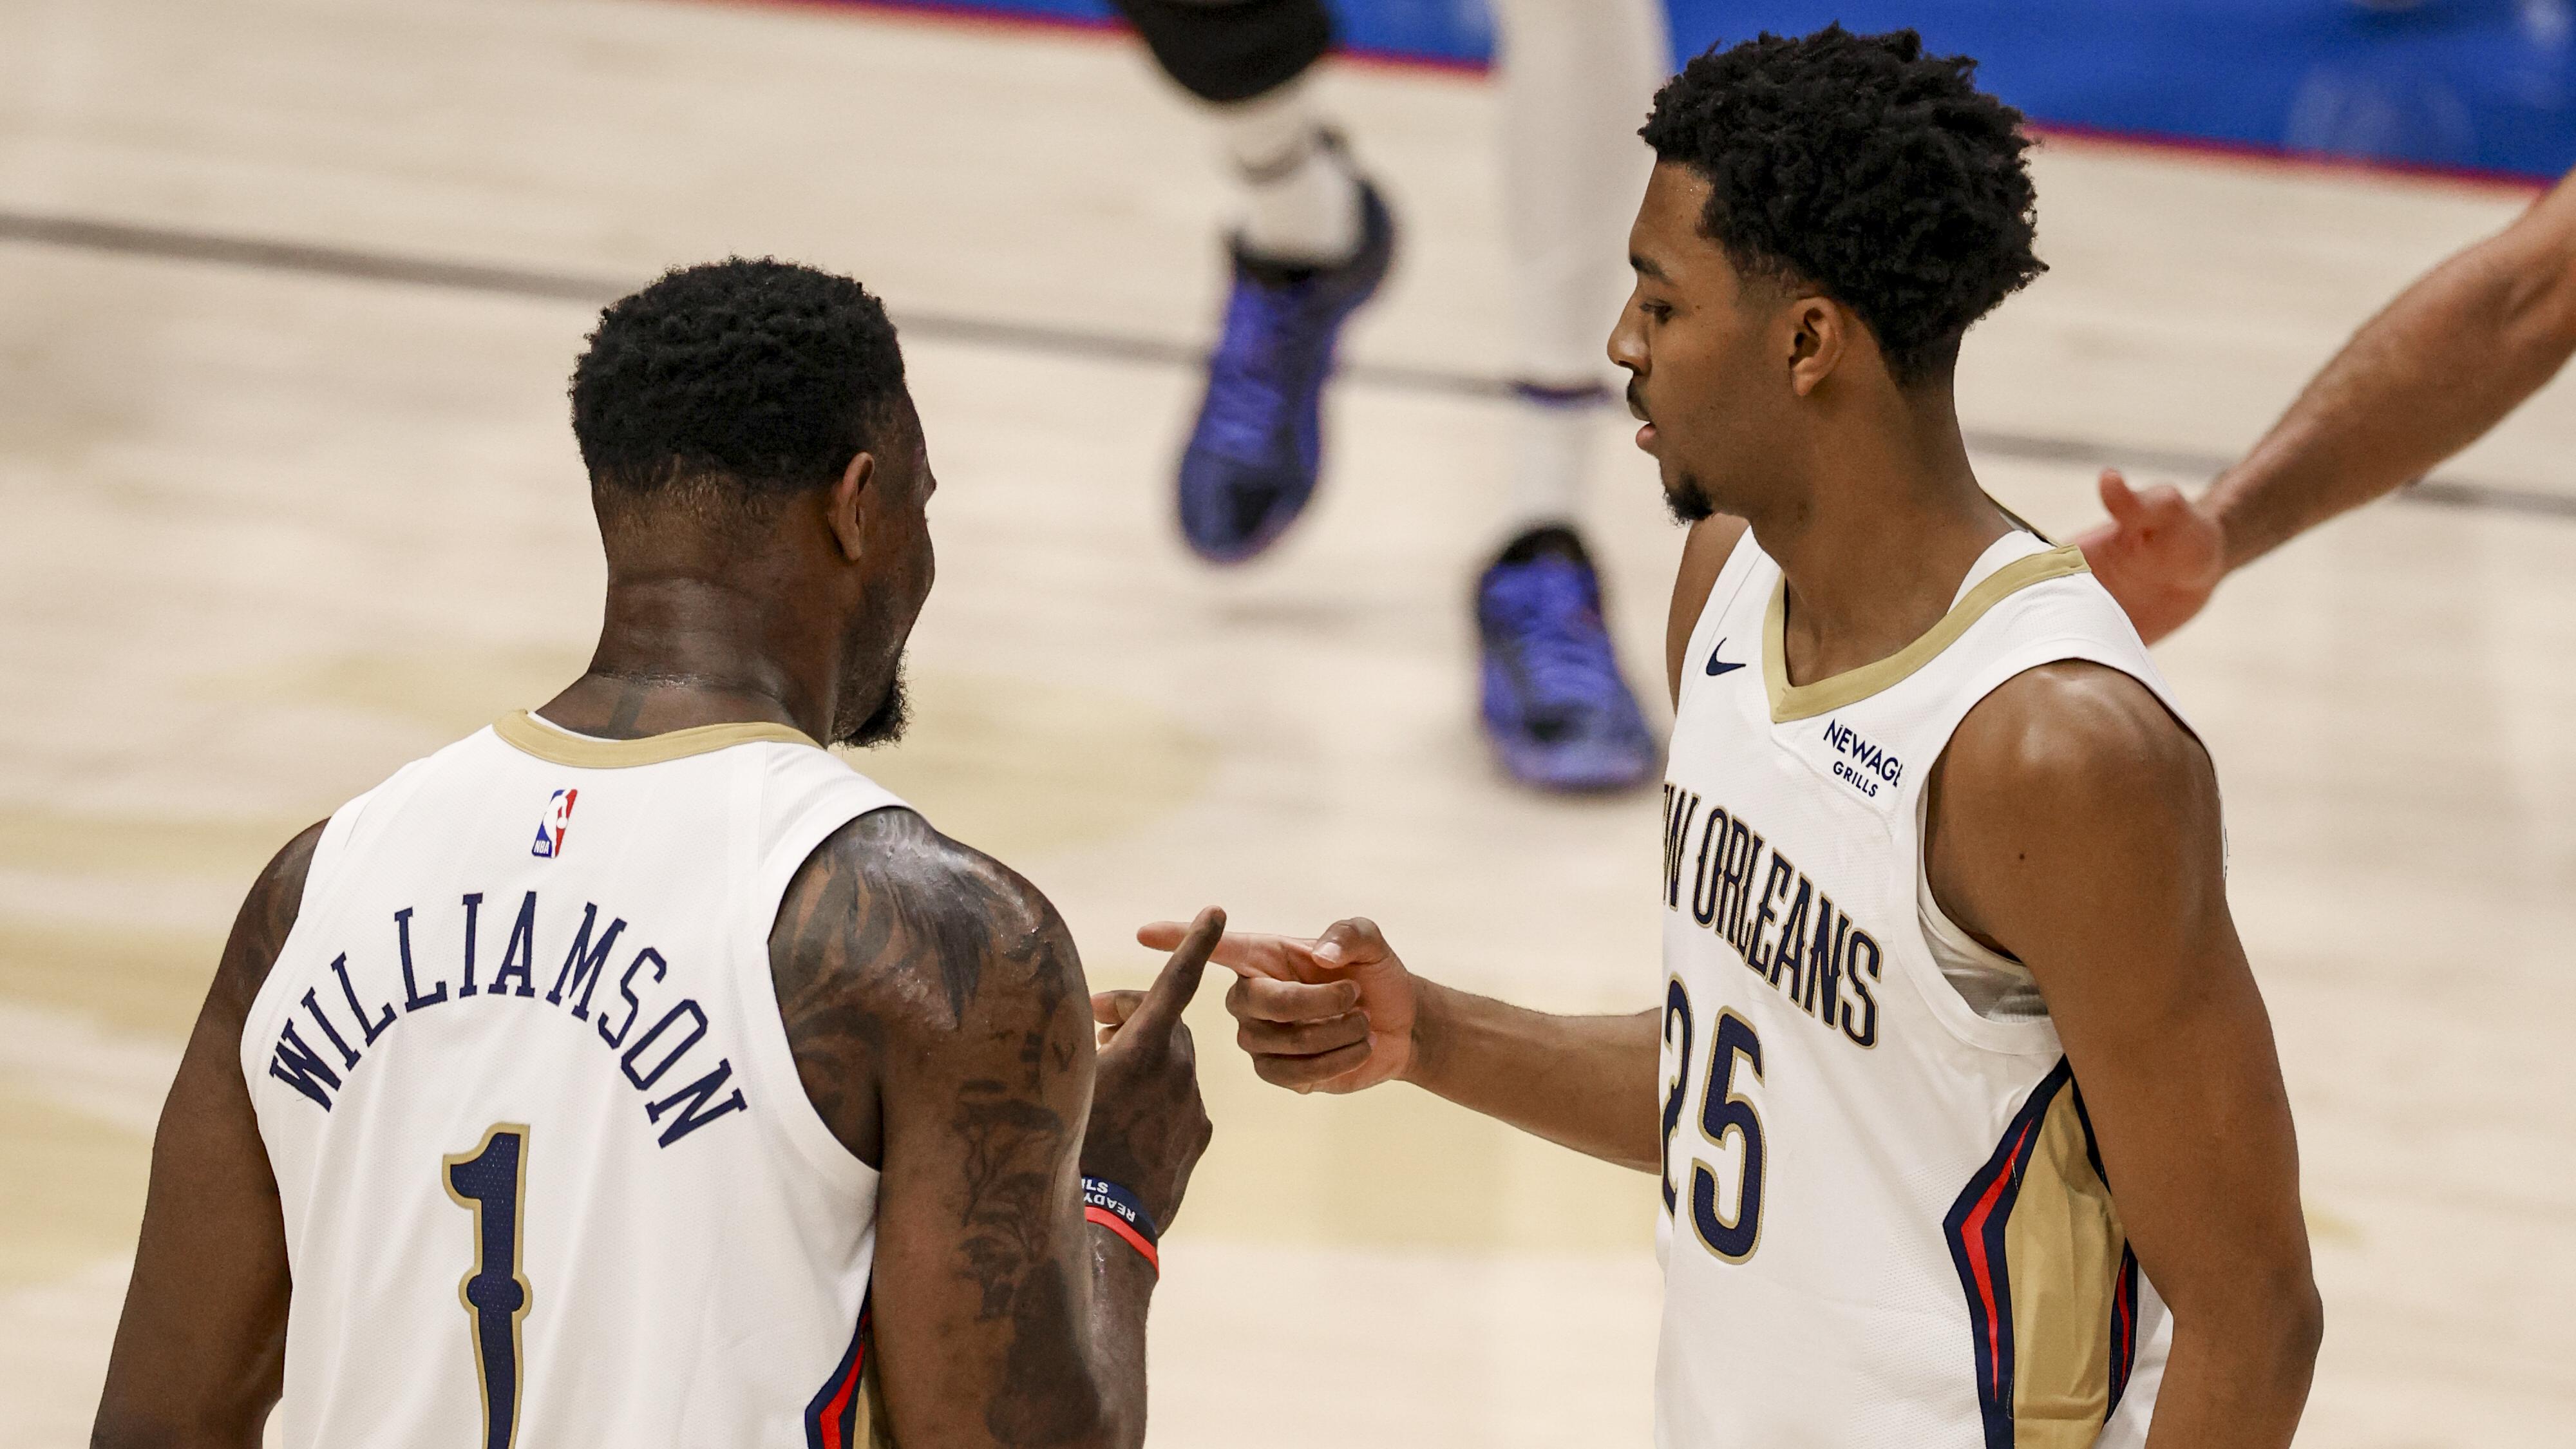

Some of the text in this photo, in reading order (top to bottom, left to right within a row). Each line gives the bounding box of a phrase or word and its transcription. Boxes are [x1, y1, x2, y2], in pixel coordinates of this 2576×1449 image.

[533, 840, 550, 855] NBA
[1833, 761, 1879, 797] GRILLS
[269, 890, 748, 1150] WILLIAMSON
[1691, 805, 1884, 1051] ORLEANS
[1083, 1192, 1137, 1222] READY
[1661, 972, 1768, 1266] 25
[441, 1121, 534, 1449] 1
